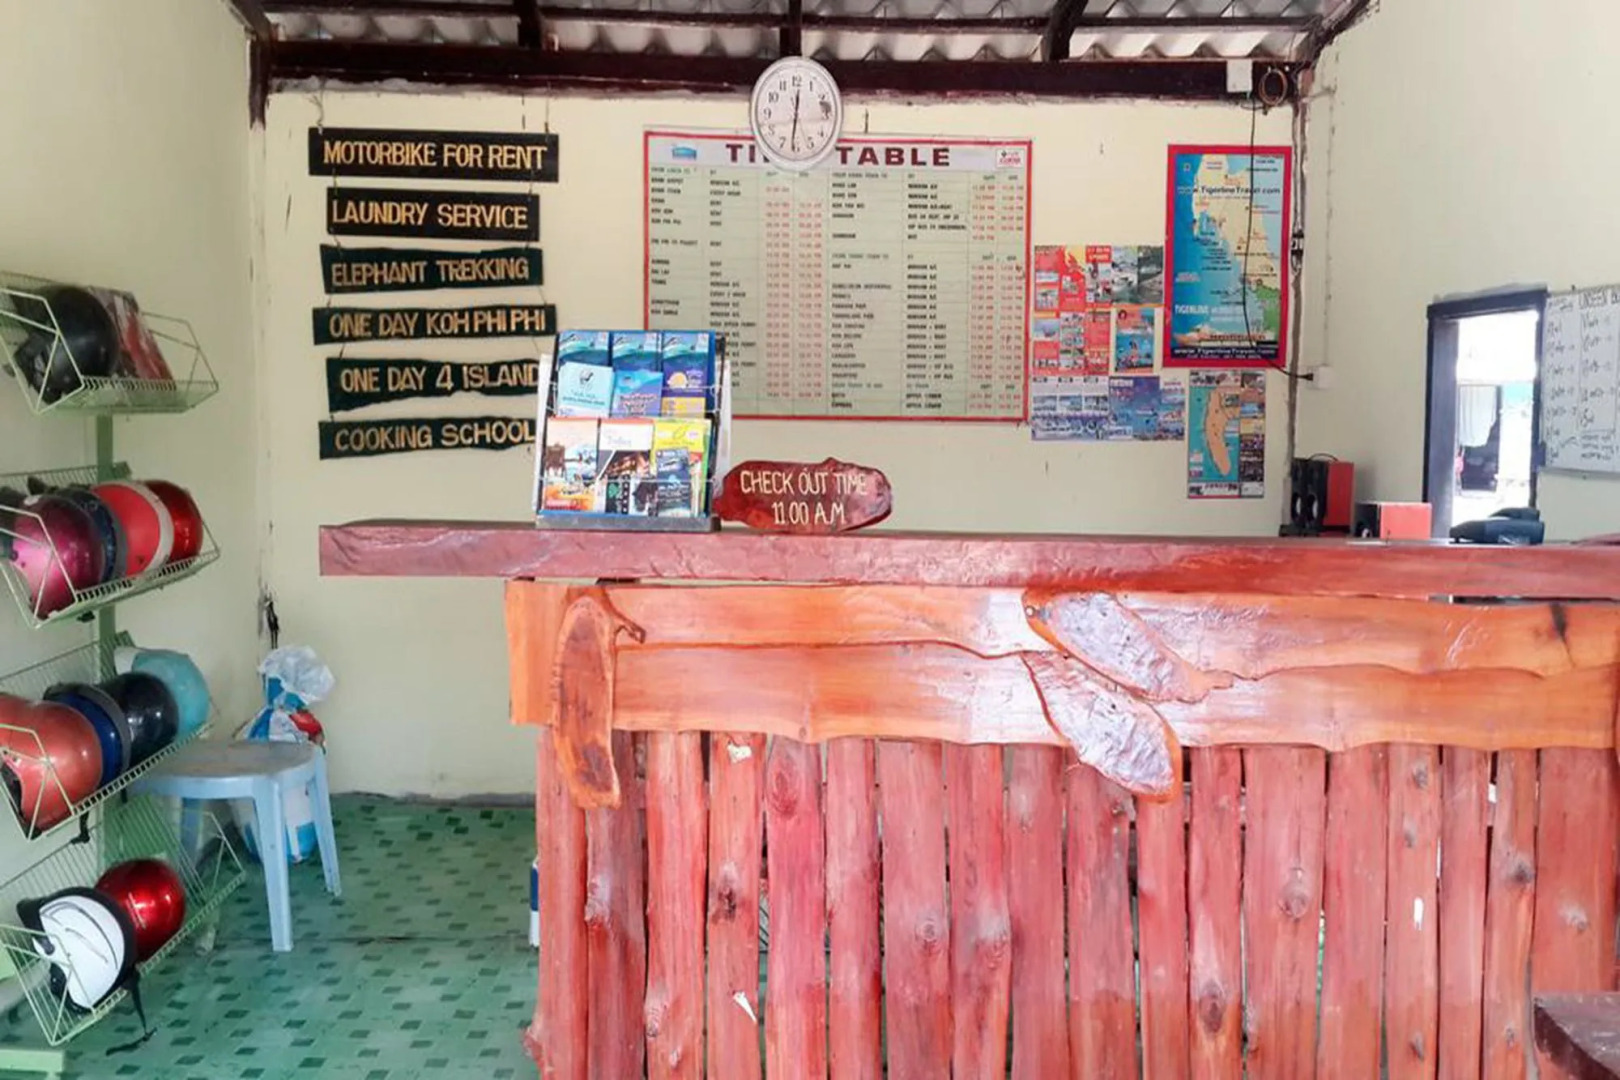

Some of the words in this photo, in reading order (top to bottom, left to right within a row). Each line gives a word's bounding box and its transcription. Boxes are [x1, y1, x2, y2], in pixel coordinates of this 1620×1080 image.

[323, 140, 437, 168] MOTORBIKE
[443, 144, 483, 168] FOR
[488, 144, 548, 171] RENT
[834, 146, 951, 167] TABLE
[332, 198, 429, 226] LAUNDRY
[437, 204, 528, 230] SERVICE
[331, 260, 427, 287] ELEPHANT
[436, 257, 529, 282] TREKKING
[329, 315, 372, 338] ONE
[378, 312, 419, 337] DAY
[426, 311, 470, 335] KOH
[473, 310, 507, 333] PHI
[510, 309, 546, 333] PHI
[340, 367, 380, 393] ONE
[388, 365, 427, 391] DAY
[435, 363, 455, 391] 4
[462, 362, 539, 389] ISLAND
[334, 425, 432, 451] COOKING
[441, 420, 536, 446] SCHOOL
[740, 469, 796, 496] CHECK
[798, 470, 829, 496] OUT
[833, 472, 869, 496] TIME
